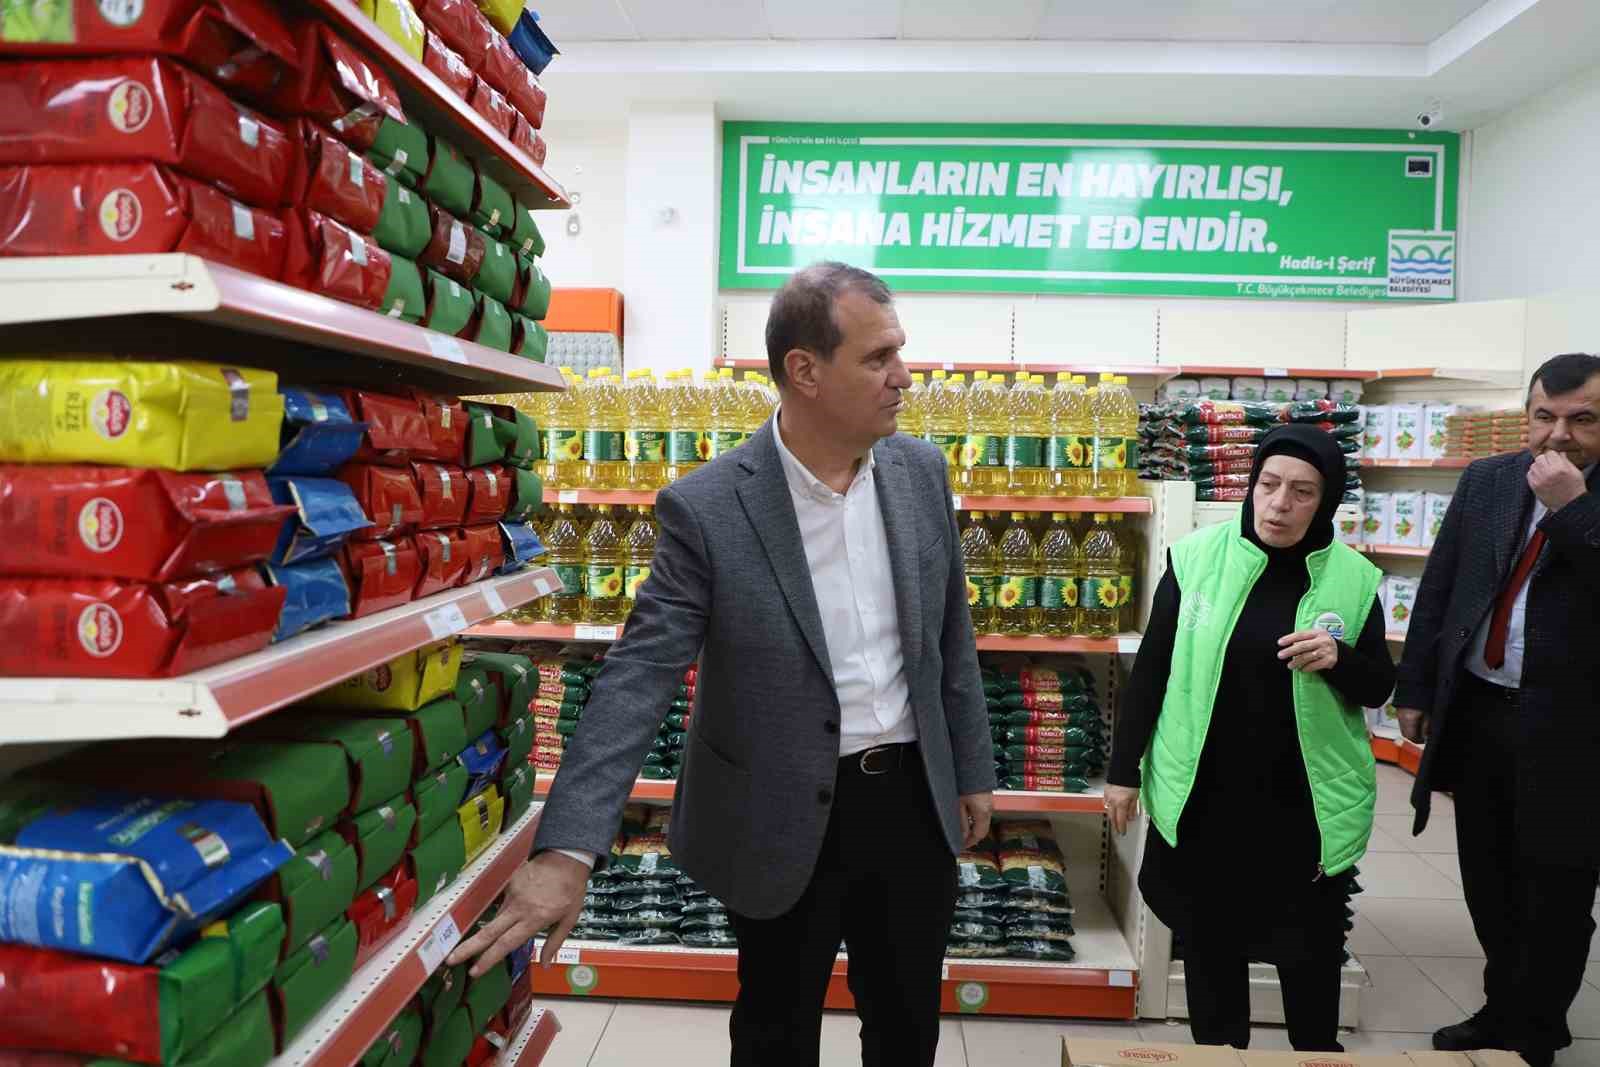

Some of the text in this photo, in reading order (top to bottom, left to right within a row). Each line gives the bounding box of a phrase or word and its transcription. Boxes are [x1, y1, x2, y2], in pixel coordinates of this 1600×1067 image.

[759, 153, 1293, 206] İNSANLARIN EN HAYIRLISI,
[758, 205, 1278, 254] İNSANA HİZMET EDENDİR.
[1337, 256, 1376, 274] Şerif
[1390, 275, 1451, 286] BÜYÜKÇEKMECE
[1258, 284, 1335, 297] Büyükçekmece
[1390, 285, 1431, 293] BELEDİYESİ
